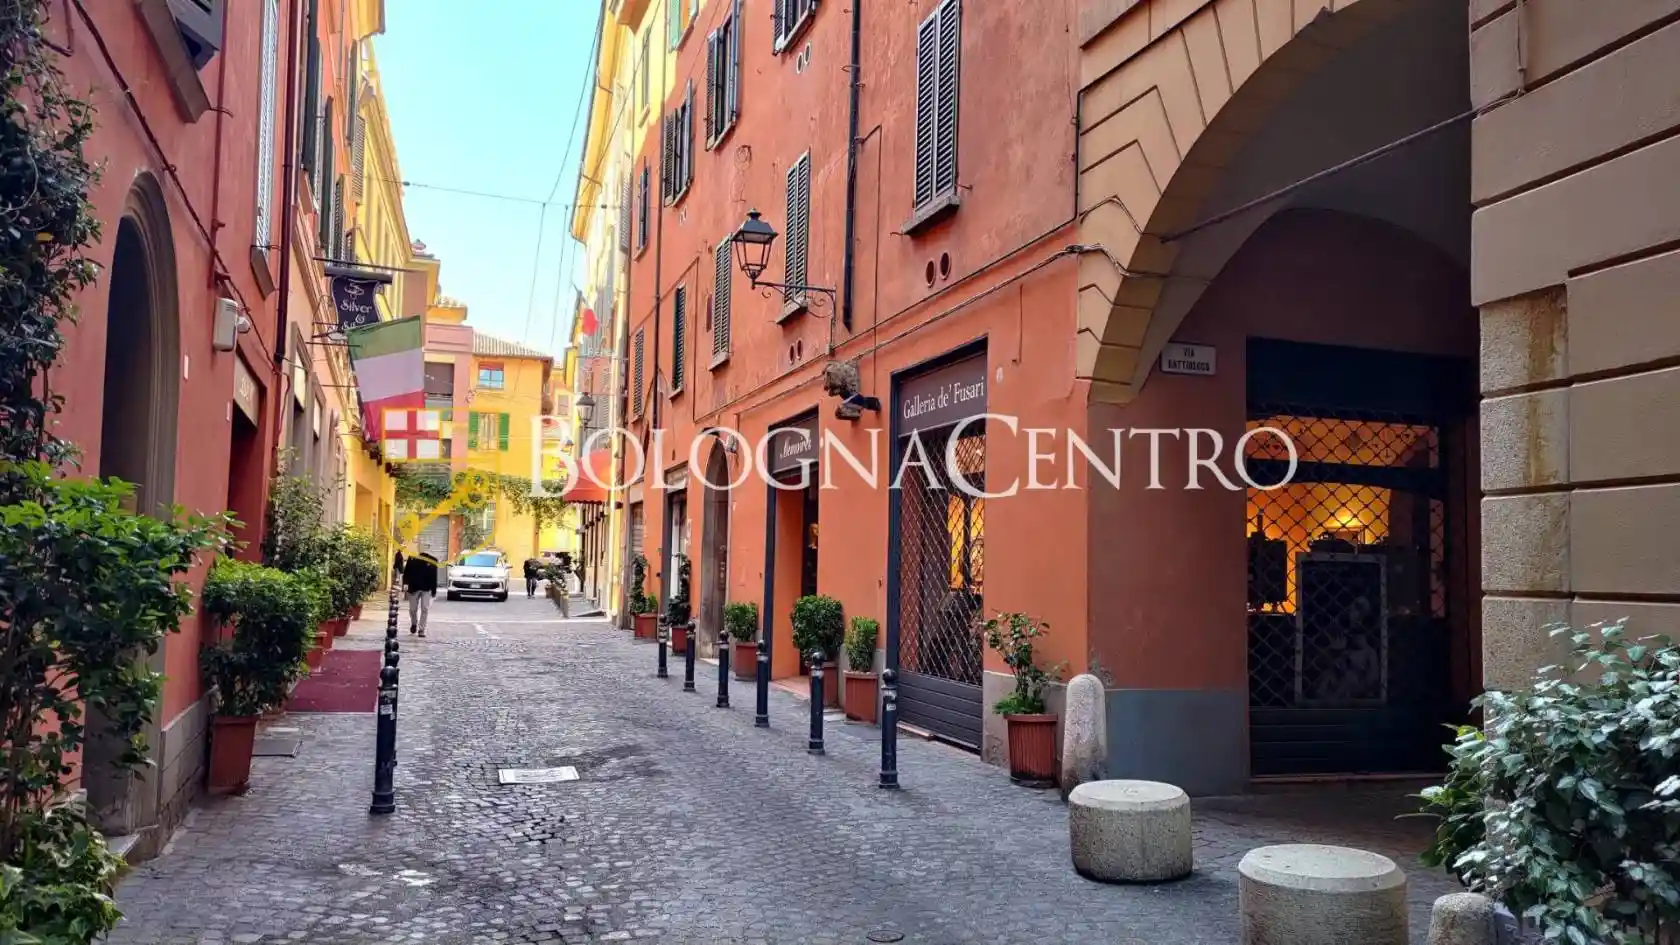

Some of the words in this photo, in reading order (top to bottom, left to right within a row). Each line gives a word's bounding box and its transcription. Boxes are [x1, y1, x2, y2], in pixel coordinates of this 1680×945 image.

[340, 299, 372, 314] Silver
[903, 393, 937, 419] Galleria
[937, 384, 952, 409] de'
[953, 376, 985, 404] Fusari
